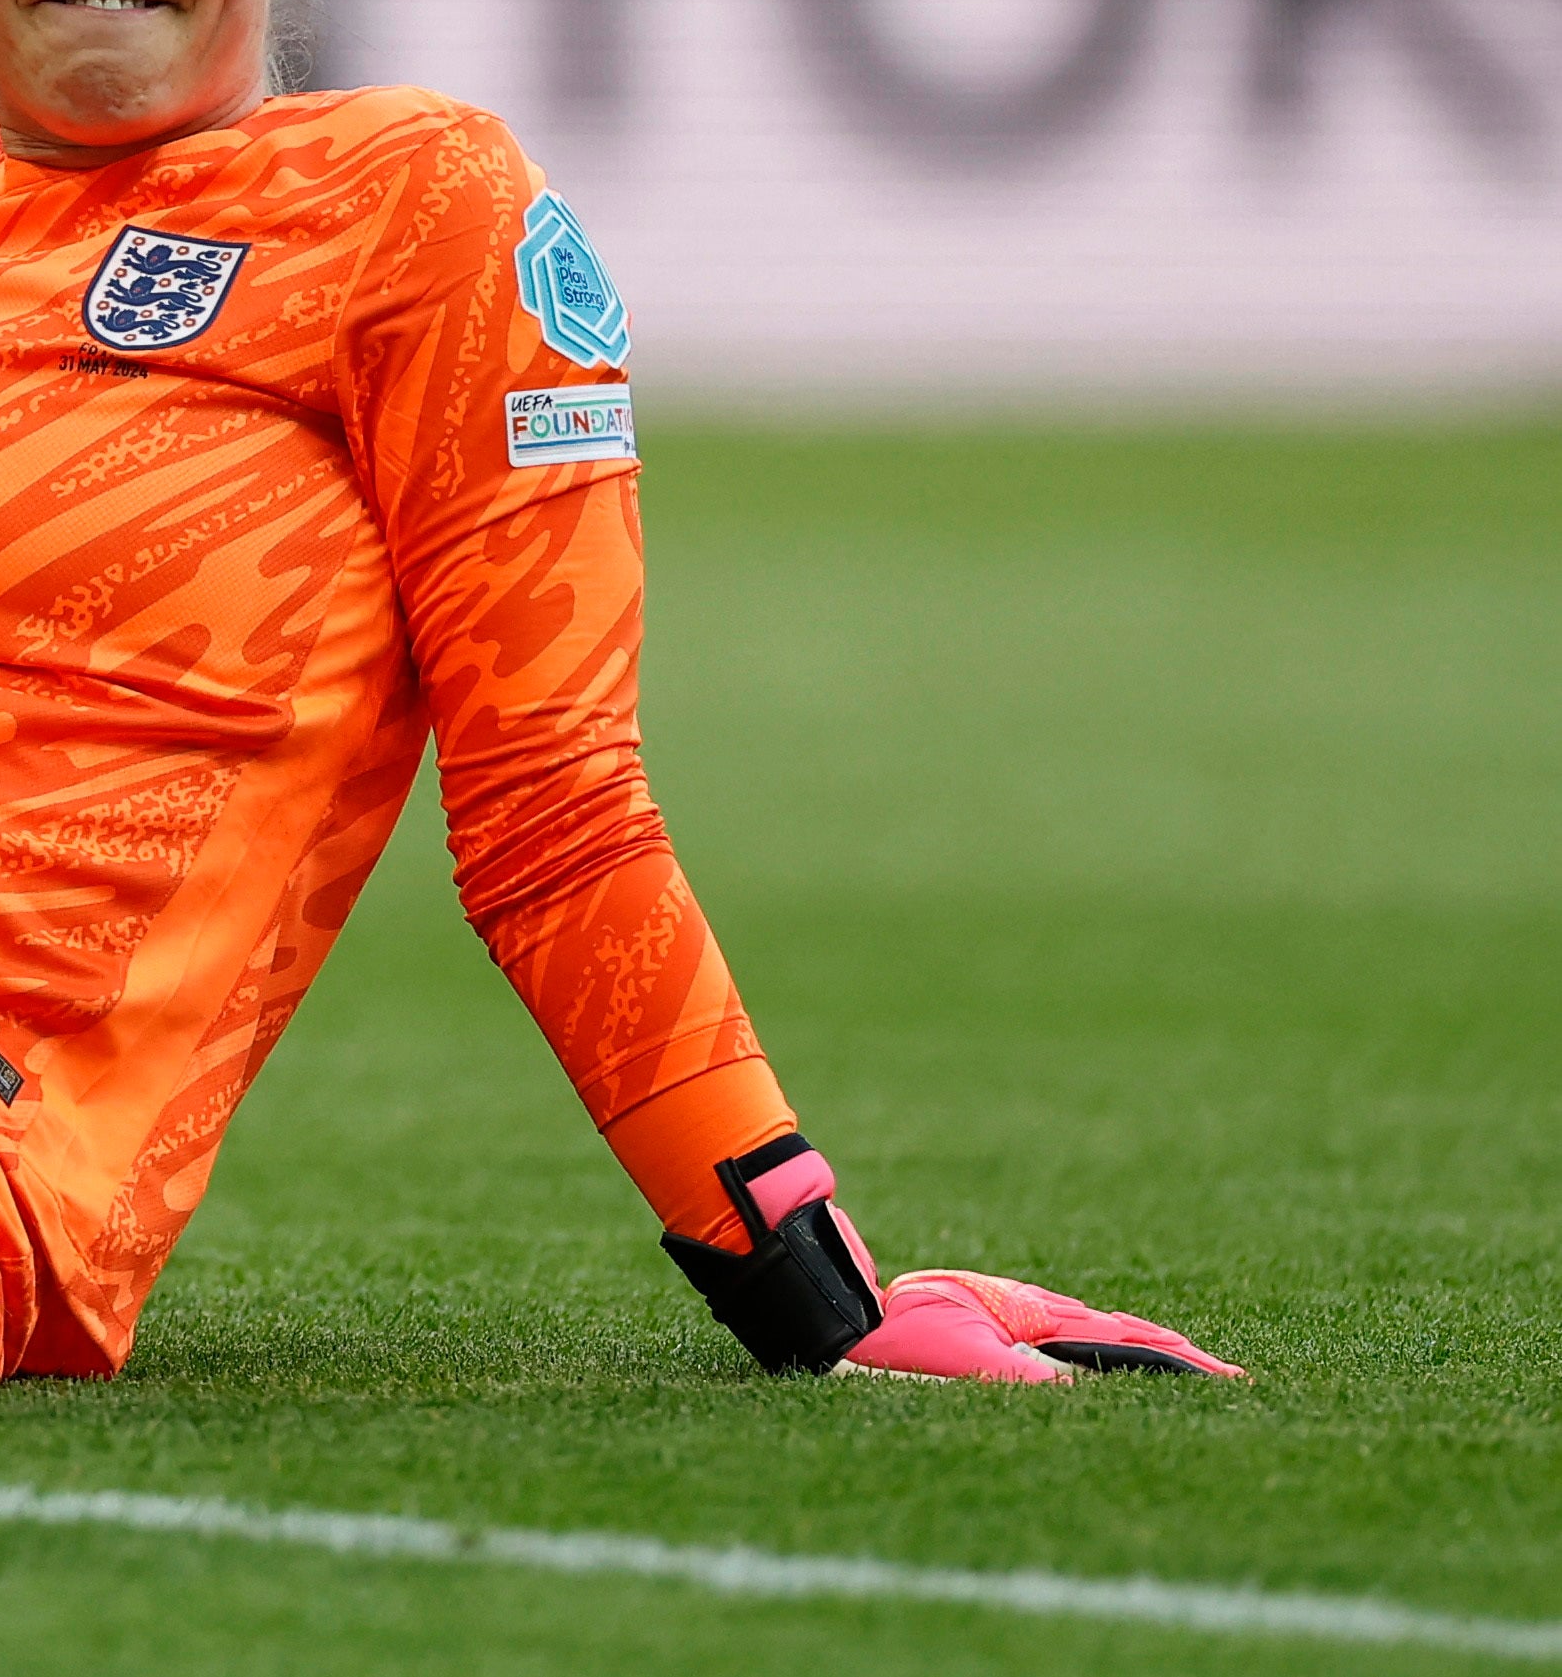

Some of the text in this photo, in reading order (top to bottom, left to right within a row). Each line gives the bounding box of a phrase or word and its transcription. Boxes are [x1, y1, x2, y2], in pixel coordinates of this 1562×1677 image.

[551, 245, 574, 264] We
[559, 266, 588, 289] Play
[563, 286, 605, 312] Strong
[77, 357, 109, 375] MAY
[112, 361, 149, 379] 2024
[511, 394, 554, 412] UEFA
